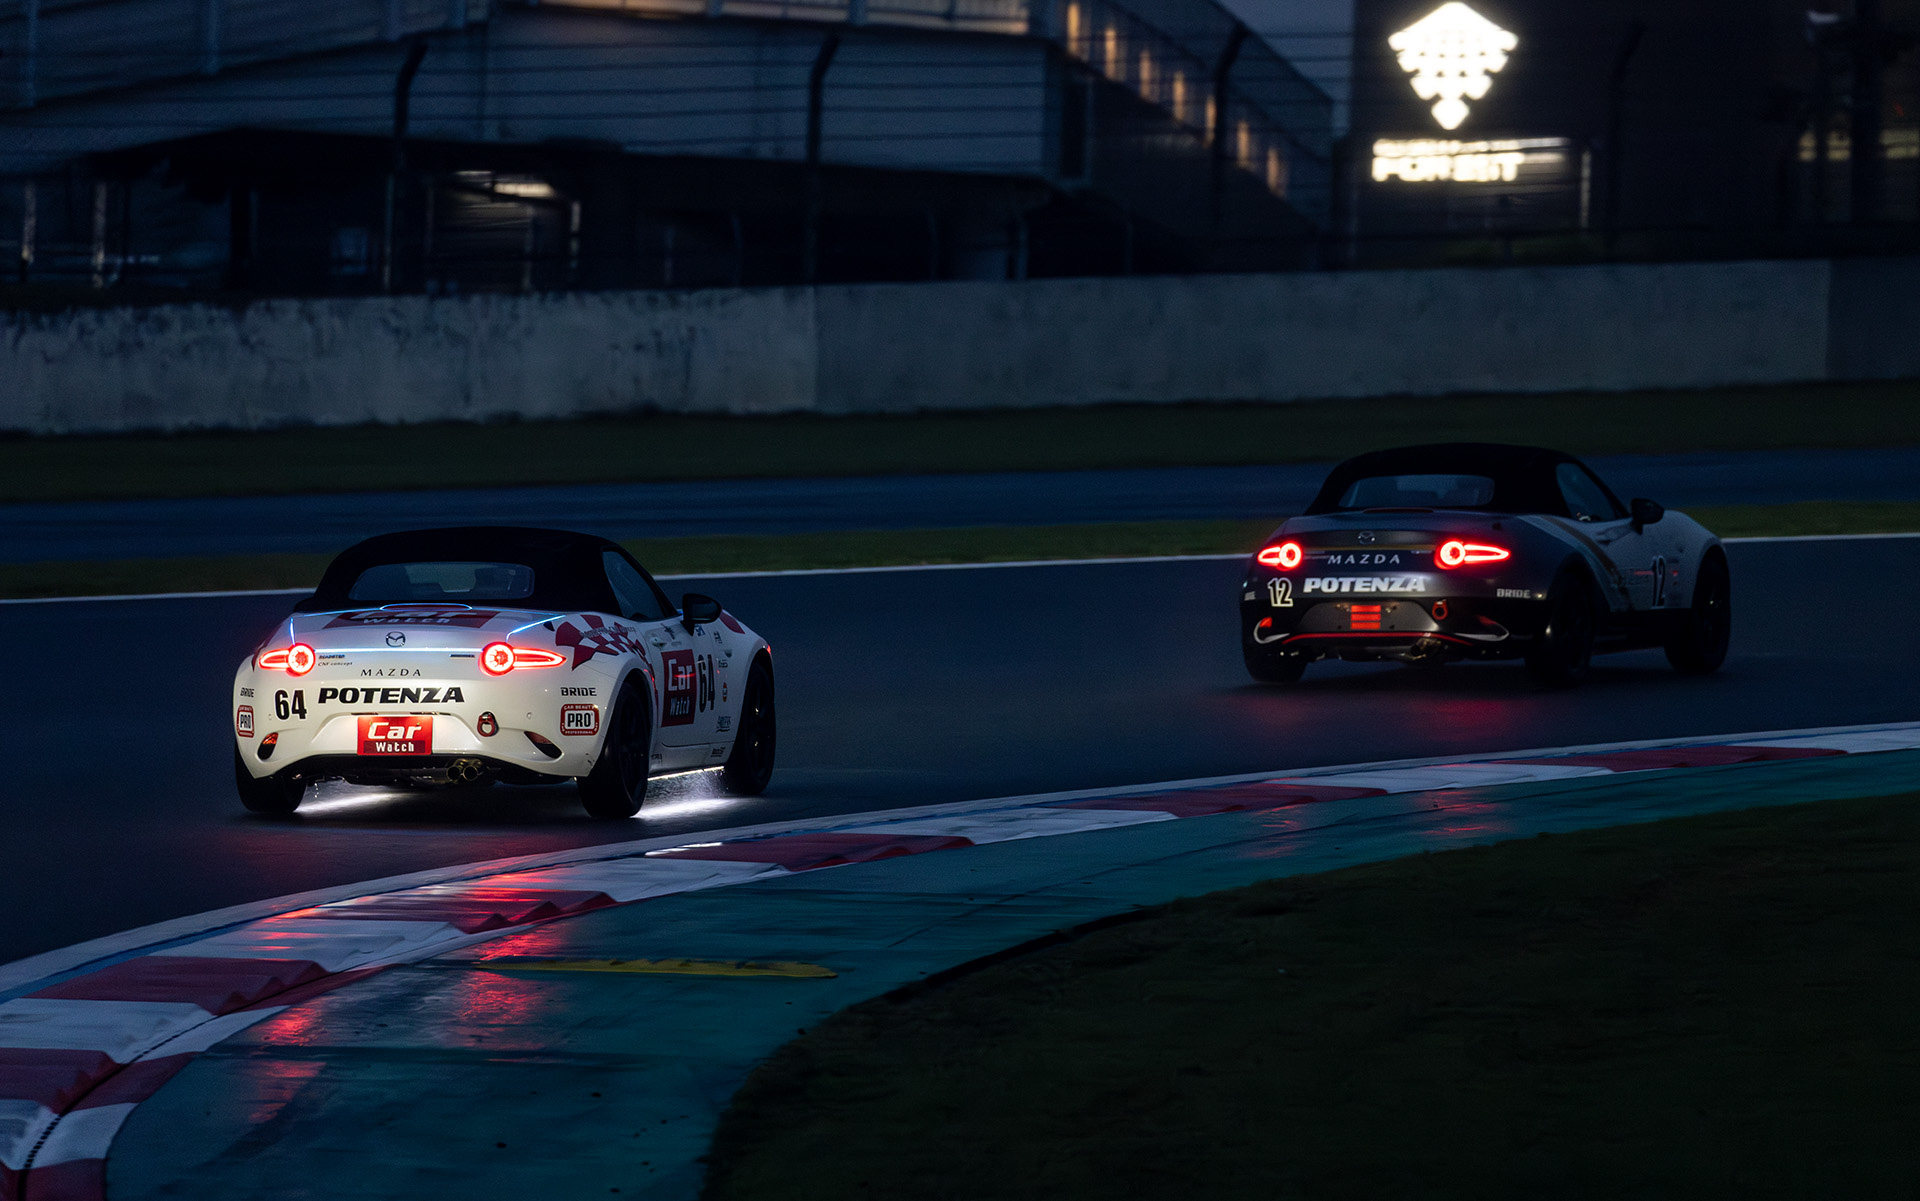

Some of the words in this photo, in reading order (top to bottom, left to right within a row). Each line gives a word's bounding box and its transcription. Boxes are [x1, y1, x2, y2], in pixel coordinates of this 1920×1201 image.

[1327, 554, 1400, 564] MAZDA
[1302, 577, 1426, 593] POTENZA
[1650, 555, 1665, 609] 12
[1267, 577, 1294, 607] 12
[1496, 588, 1531, 599] BRIDE
[360, 668, 422, 677] MAZDA
[667, 658, 693, 692] Car
[560, 687, 597, 696] BRIDE
[697, 654, 715, 713] 64
[240, 687, 255, 698] BRIDE
[318, 687, 465, 703] POTENZA
[275, 690, 307, 720] 64
[567, 712, 591, 727] PRO
[368, 722, 422, 739] Car
[375, 742, 415, 753] Watch
